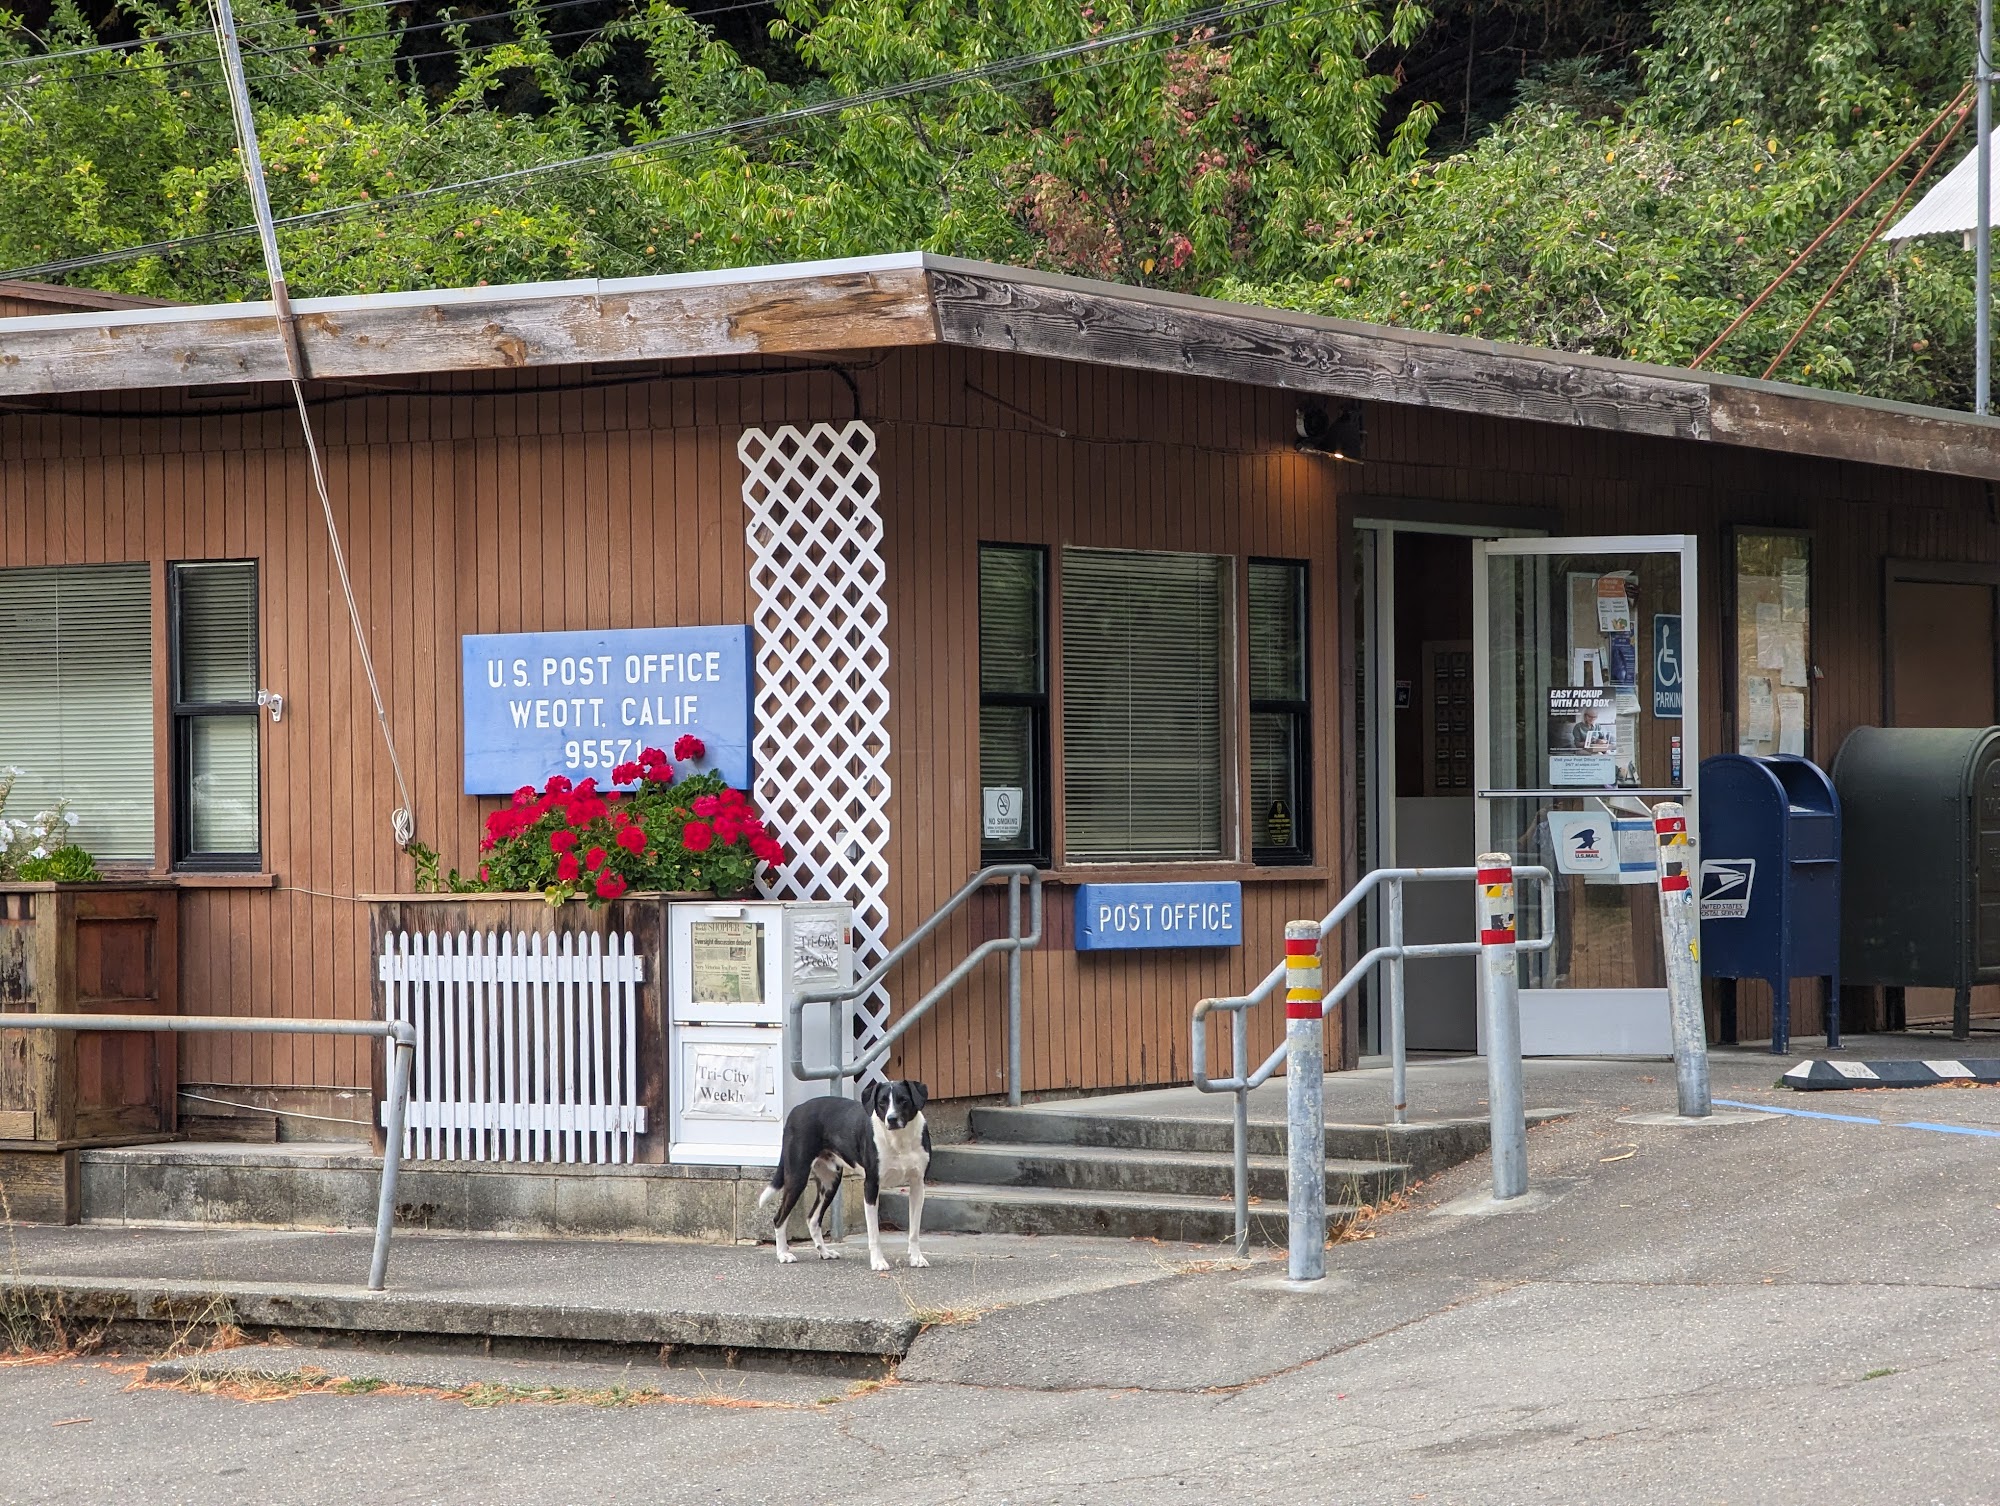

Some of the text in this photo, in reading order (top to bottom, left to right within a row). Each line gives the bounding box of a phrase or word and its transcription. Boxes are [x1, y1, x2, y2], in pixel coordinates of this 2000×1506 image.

[487, 651, 720, 688] U.S. POST OFFICE
[1550, 689, 1603, 699] EASY PICKUP
[1656, 691, 1682, 708] PARKIN
[621, 695, 698, 726] CALIF.
[1550, 699, 1573, 708] WITH
[1573, 699, 1579, 707] A
[1580, 699, 1592, 707] PO
[565, 739, 642, 769] 95571
[1100, 901, 1233, 932] POST OFFICE
[708, 922, 740, 932] SHOPPER
[694, 938, 714, 946] Oversight
[714, 938, 736, 946] discussion
[799, 934, 836, 949] Tri-City
[800, 954, 834, 968] Weekly
[699, 1066, 749, 1087] Tri-City
[700, 1086, 746, 1102] Weekly
